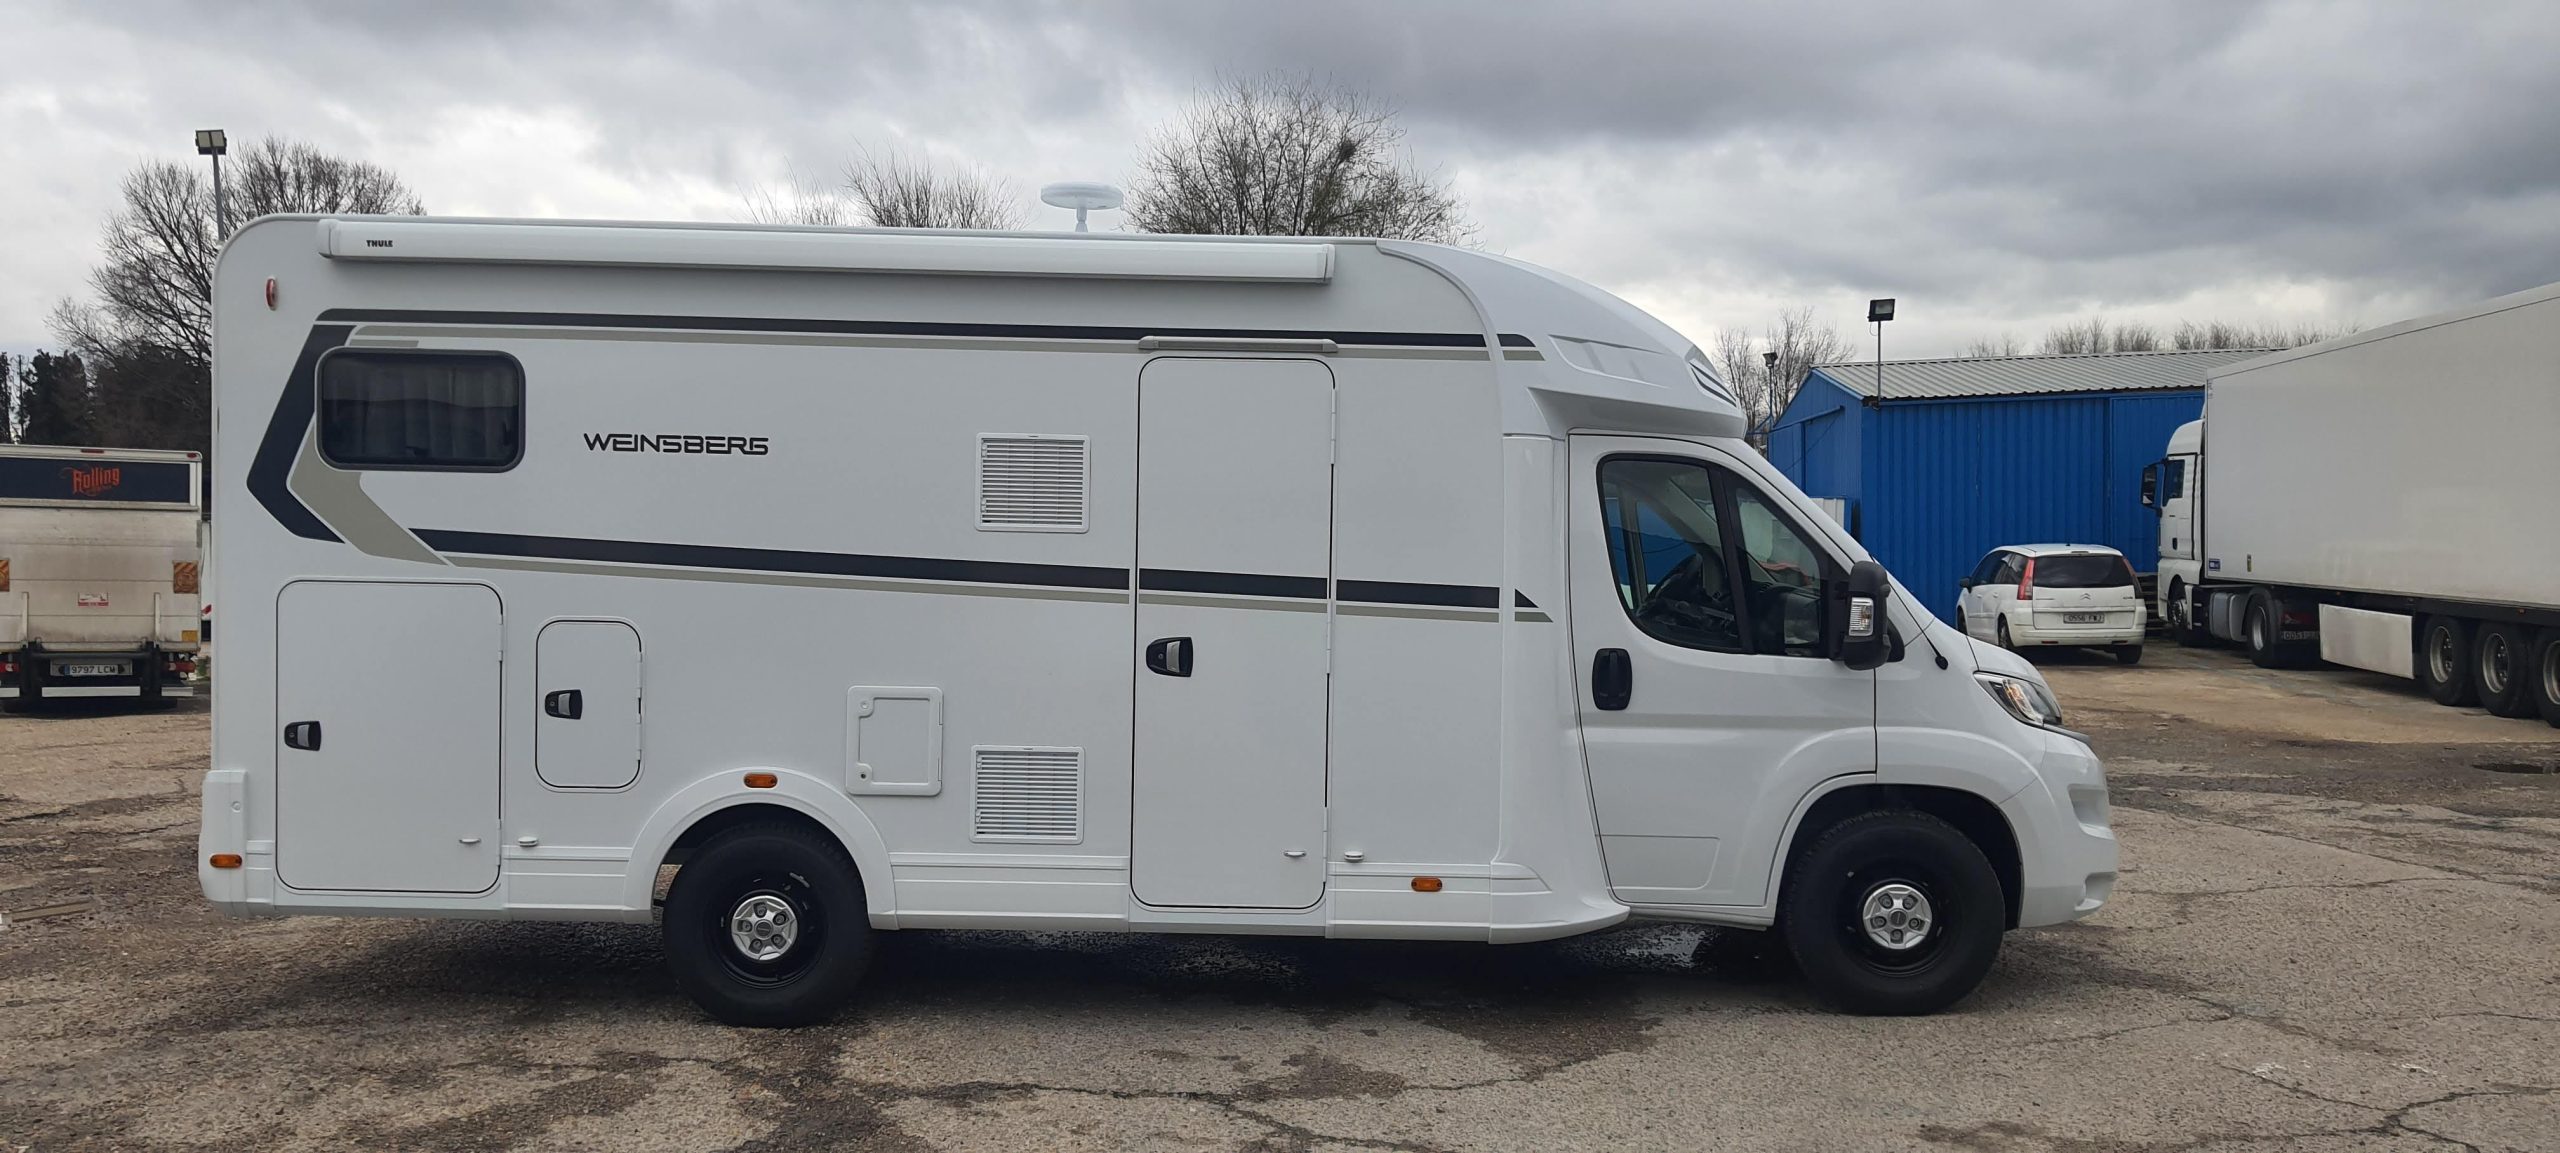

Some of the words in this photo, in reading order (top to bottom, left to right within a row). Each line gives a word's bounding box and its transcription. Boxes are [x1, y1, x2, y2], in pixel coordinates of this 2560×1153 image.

[584, 433, 769, 455] WEINSBERG
[72, 466, 120, 495] Rolling
[71, 665, 95, 674] 9797
